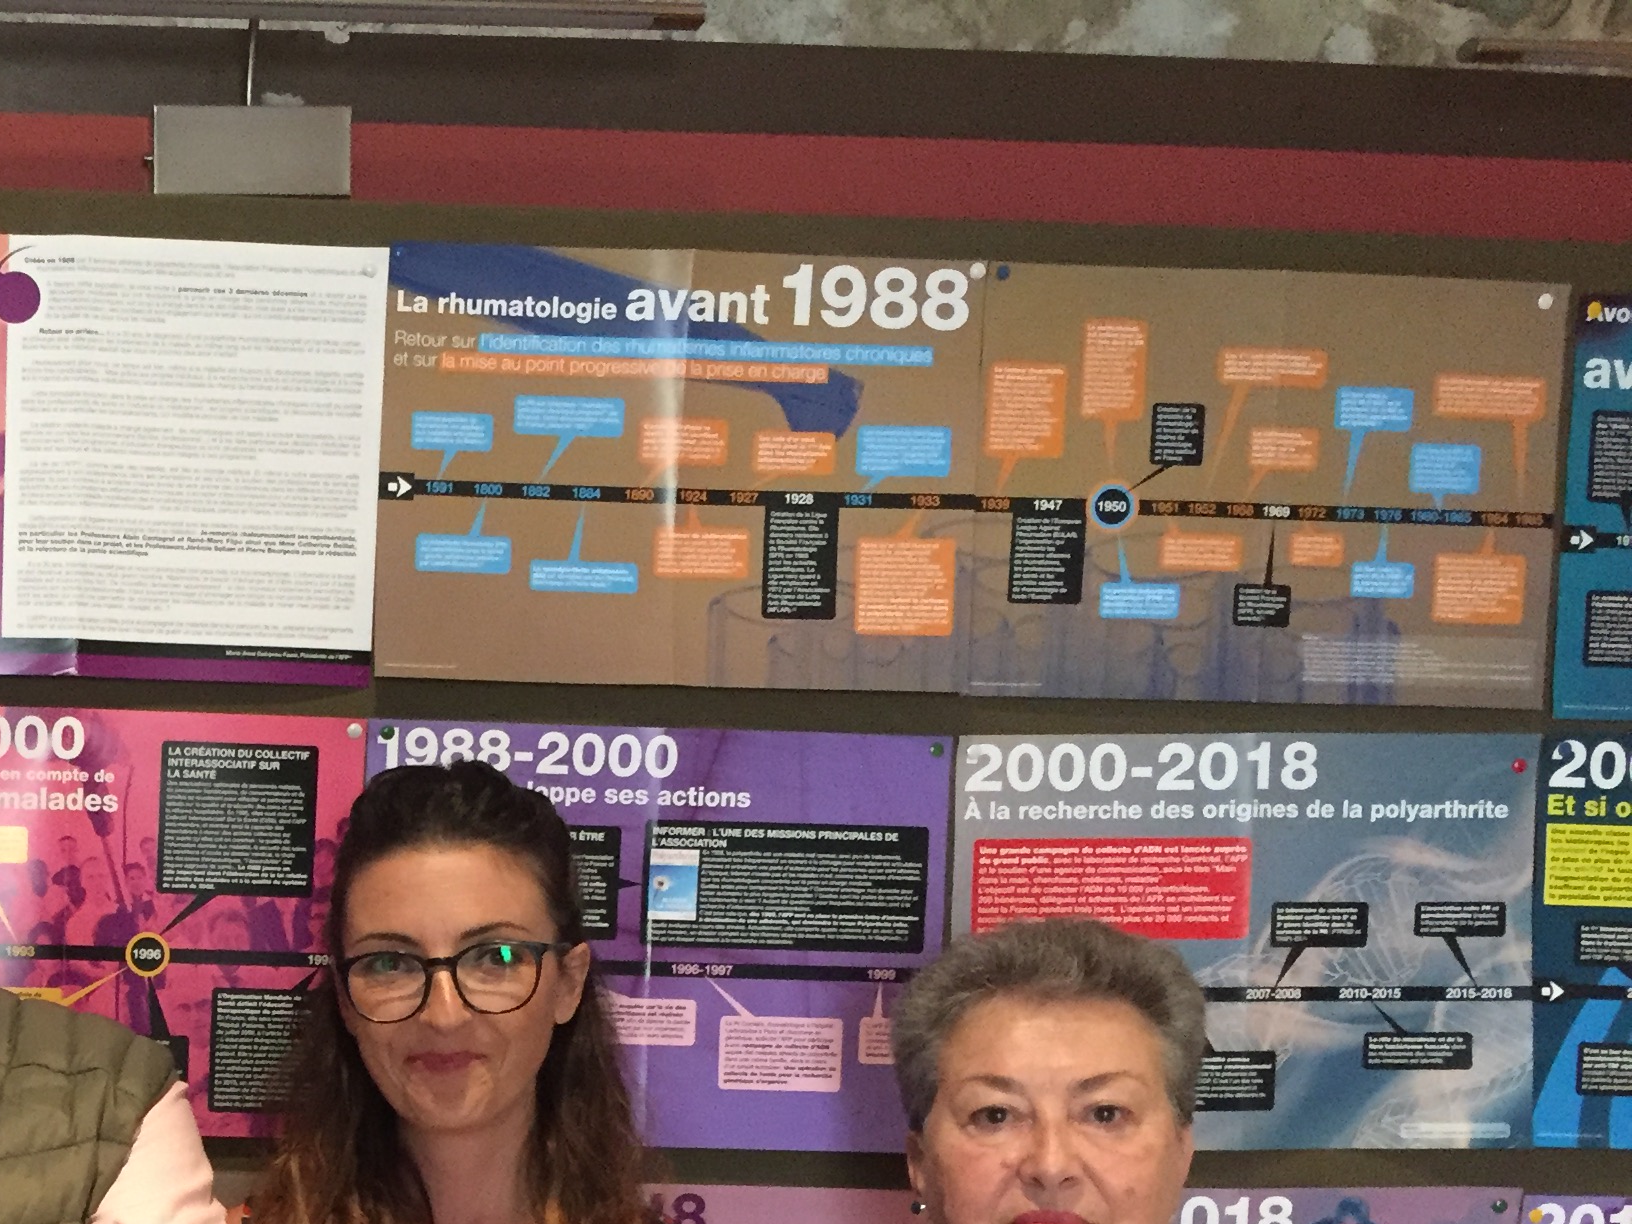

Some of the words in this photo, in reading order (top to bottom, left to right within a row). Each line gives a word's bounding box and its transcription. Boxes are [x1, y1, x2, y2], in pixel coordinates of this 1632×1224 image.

[397, 290, 428, 314] La
[437, 291, 617, 324] rhumatologie
[625, 283, 770, 325] avant
[783, 263, 969, 332] 1988
[394, 330, 446, 348] Retour
[451, 336, 476, 350] sur
[481, 333, 587, 353] l'identification
[592, 337, 621, 354] des
[625, 338, 726, 357] rhumatismes
[730, 341, 842, 361] inflammatoires
[845, 345, 933, 365] chroniques
[393, 353, 409, 367] et
[413, 356, 438, 368] sur
[441, 354, 456, 369] la
[460, 355, 497, 370] mise
[501, 359, 520, 371] au
[525, 358, 566, 374] point
[569, 360, 659, 378] progressive
[690, 360, 703, 376] la
[706, 361, 745, 380] prise
[748, 365, 768, 378] en
[771, 363, 827, 382] charge
[680, 490, 707, 502] 1924
[729, 491, 759, 503] 1927
[784, 493, 814, 505] 1928
[844, 494, 873, 507] 1931
[1033, 499, 1063, 511] 1947
[1097, 500, 1127, 513] 1950
[168, 747, 182, 757] LA
[183, 746, 236, 758] CRÉATION
[237, 748, 253, 759] DU
[254, 750, 311, 761] COLLECTIF
[377, 727, 678, 779] 1988-2000
[167, 758, 258, 770] INTERASSOCIATIF
[258, 761, 281, 771] SUR
[167, 769, 181, 779] LA
[182, 769, 218, 780] SANTÉ
[964, 741, 1318, 793] 2000-2018
[0, 769, 21, 781] en
[26, 768, 89, 784] compte
[94, 769, 115, 784] de
[604, 787, 651, 805] ses
[657, 786, 752, 808] actions
[1547, 793, 1576, 816] Et
[1584, 795, 1607, 817] si
[964, 797, 980, 820] À
[990, 800, 1011, 820] la
[1019, 800, 1142, 820] recherche
[1150, 801, 1194, 820] des
[1203, 800, 1298, 825] origines
[1306, 801, 1334, 820] de
[1342, 800, 1363, 821] la
[1371, 800, 1509, 825] polyarthrite
[651, 837, 728, 848] L'ASSOCIATION
[652, 826, 706, 836] INFORMER
[744, 828, 765, 838] DES
[767, 829, 816, 840] MISSIONS
[818, 830, 883, 842] PRINCIPALES
[884, 832, 900, 842] DE
[132, 948, 162, 960] 1996
[1339, 988, 1402, 1000] 2010-2015
[1445, 987, 1513, 1000] 2015-2018
